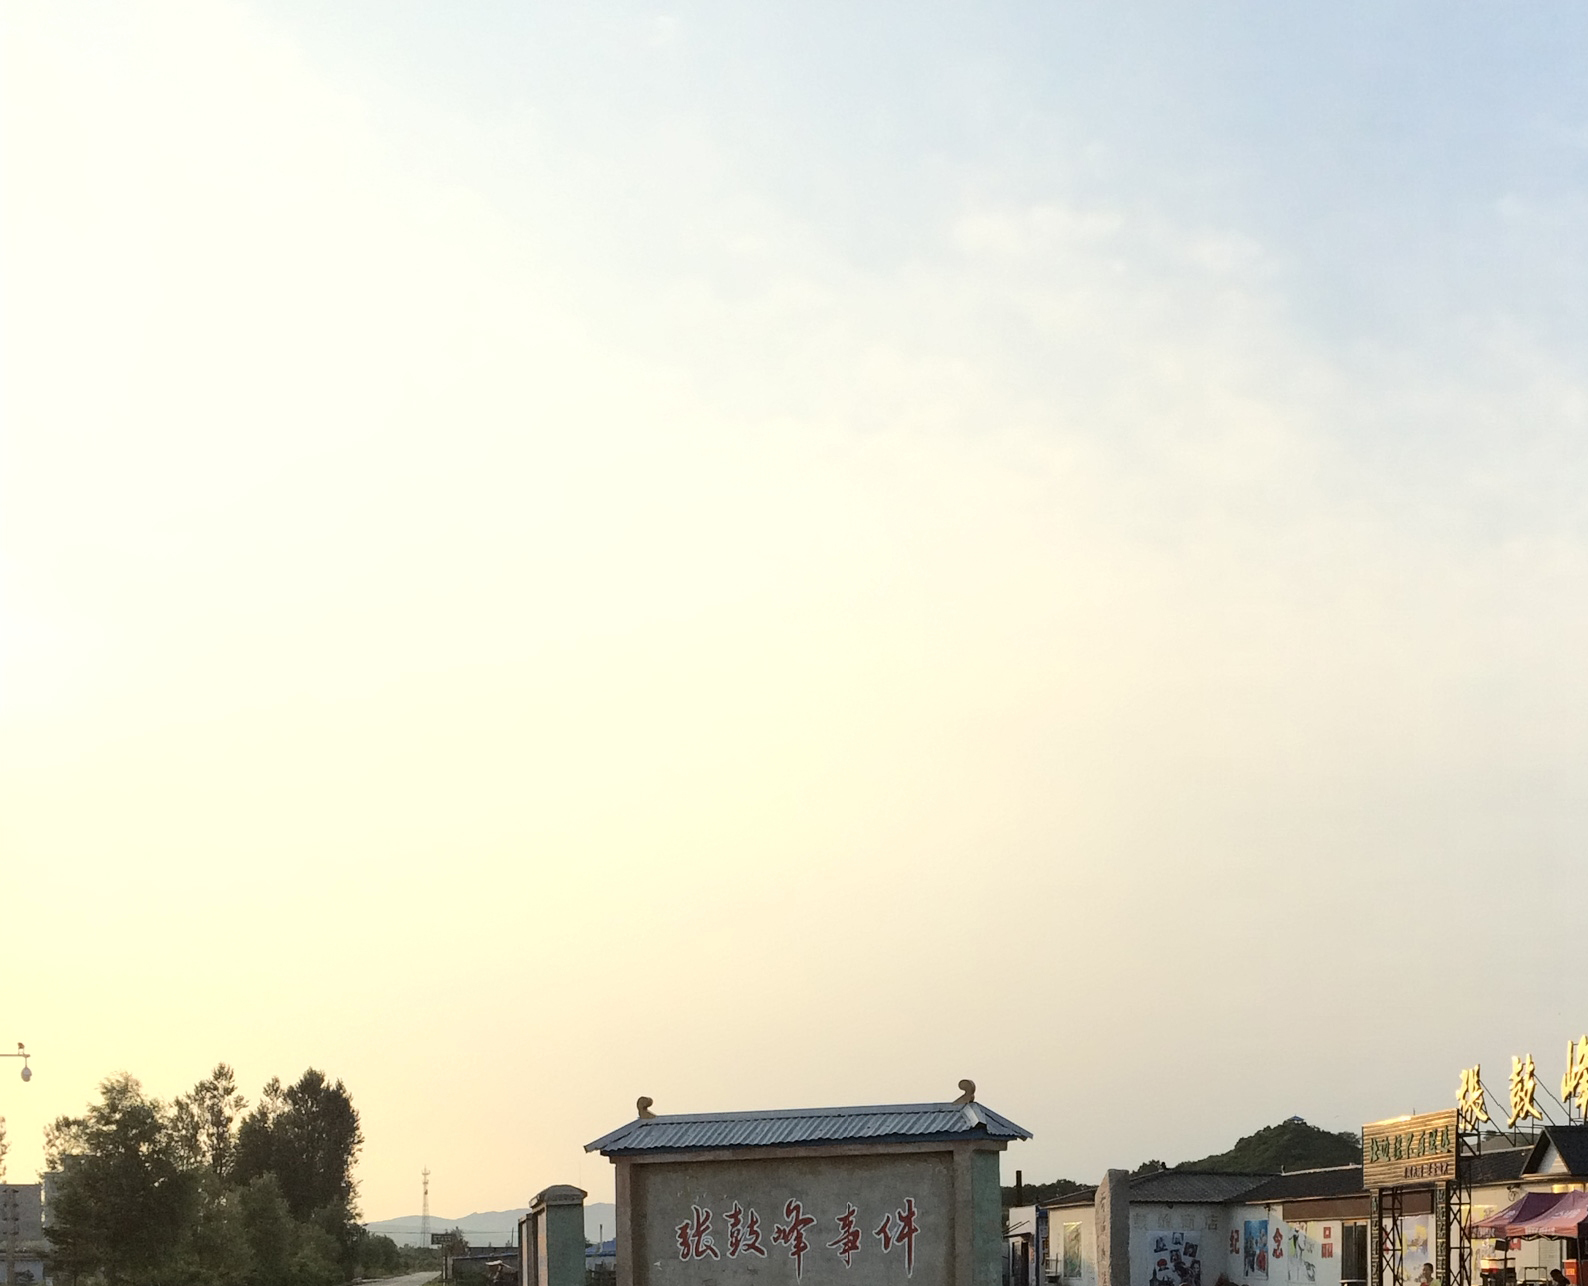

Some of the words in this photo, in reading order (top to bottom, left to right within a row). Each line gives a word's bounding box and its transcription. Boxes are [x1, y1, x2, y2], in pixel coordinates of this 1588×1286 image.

[676, 1198, 919, 1281] 张鼓峰事件
